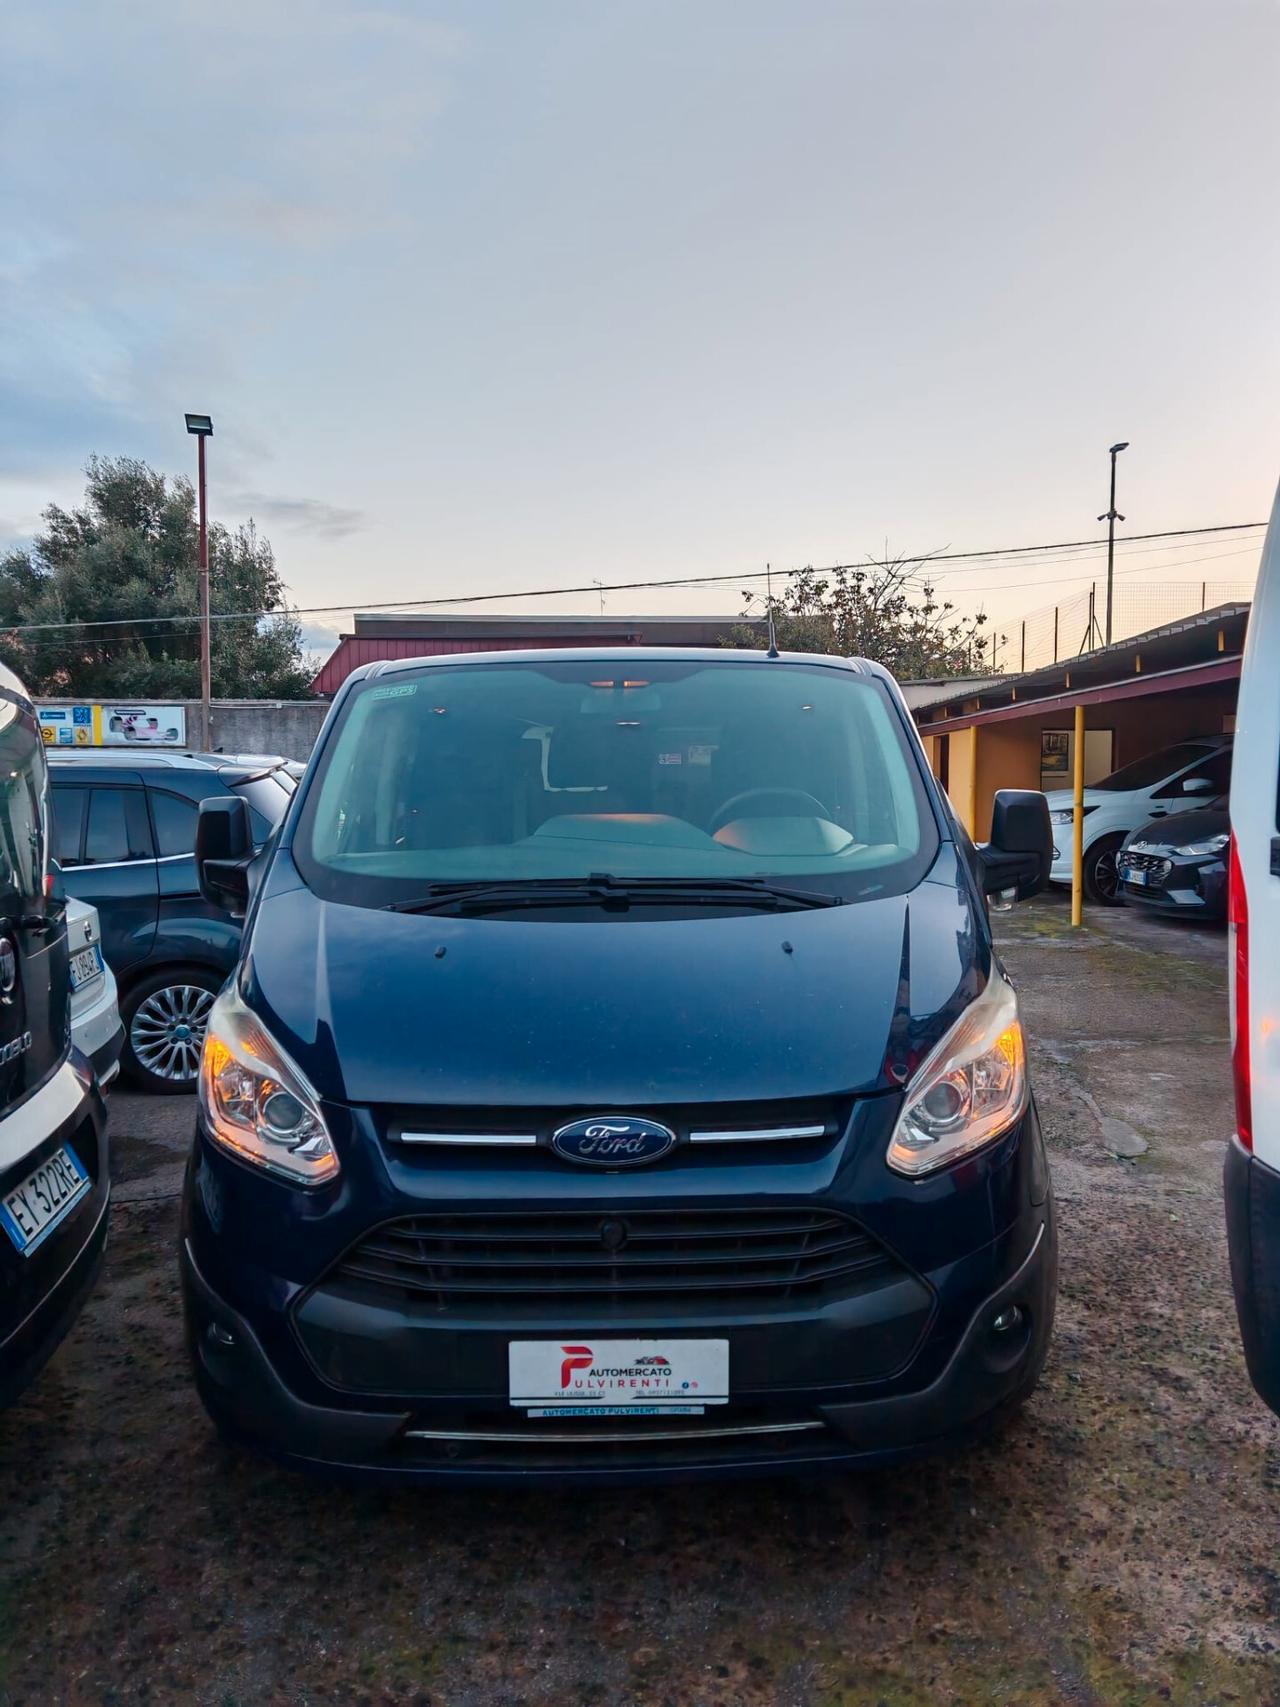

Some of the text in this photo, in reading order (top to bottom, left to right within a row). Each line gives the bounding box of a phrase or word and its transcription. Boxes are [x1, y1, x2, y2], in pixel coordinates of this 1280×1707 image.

[578, 1124, 648, 1154] Ford
[7, 1152, 80, 1238] EY 322RE
[589, 1367, 672, 1377] AUTOMERCATO
[542, 1407, 606, 1416] AUTOMERCATO
[608, 1406, 660, 1415] PULVIRENTI
